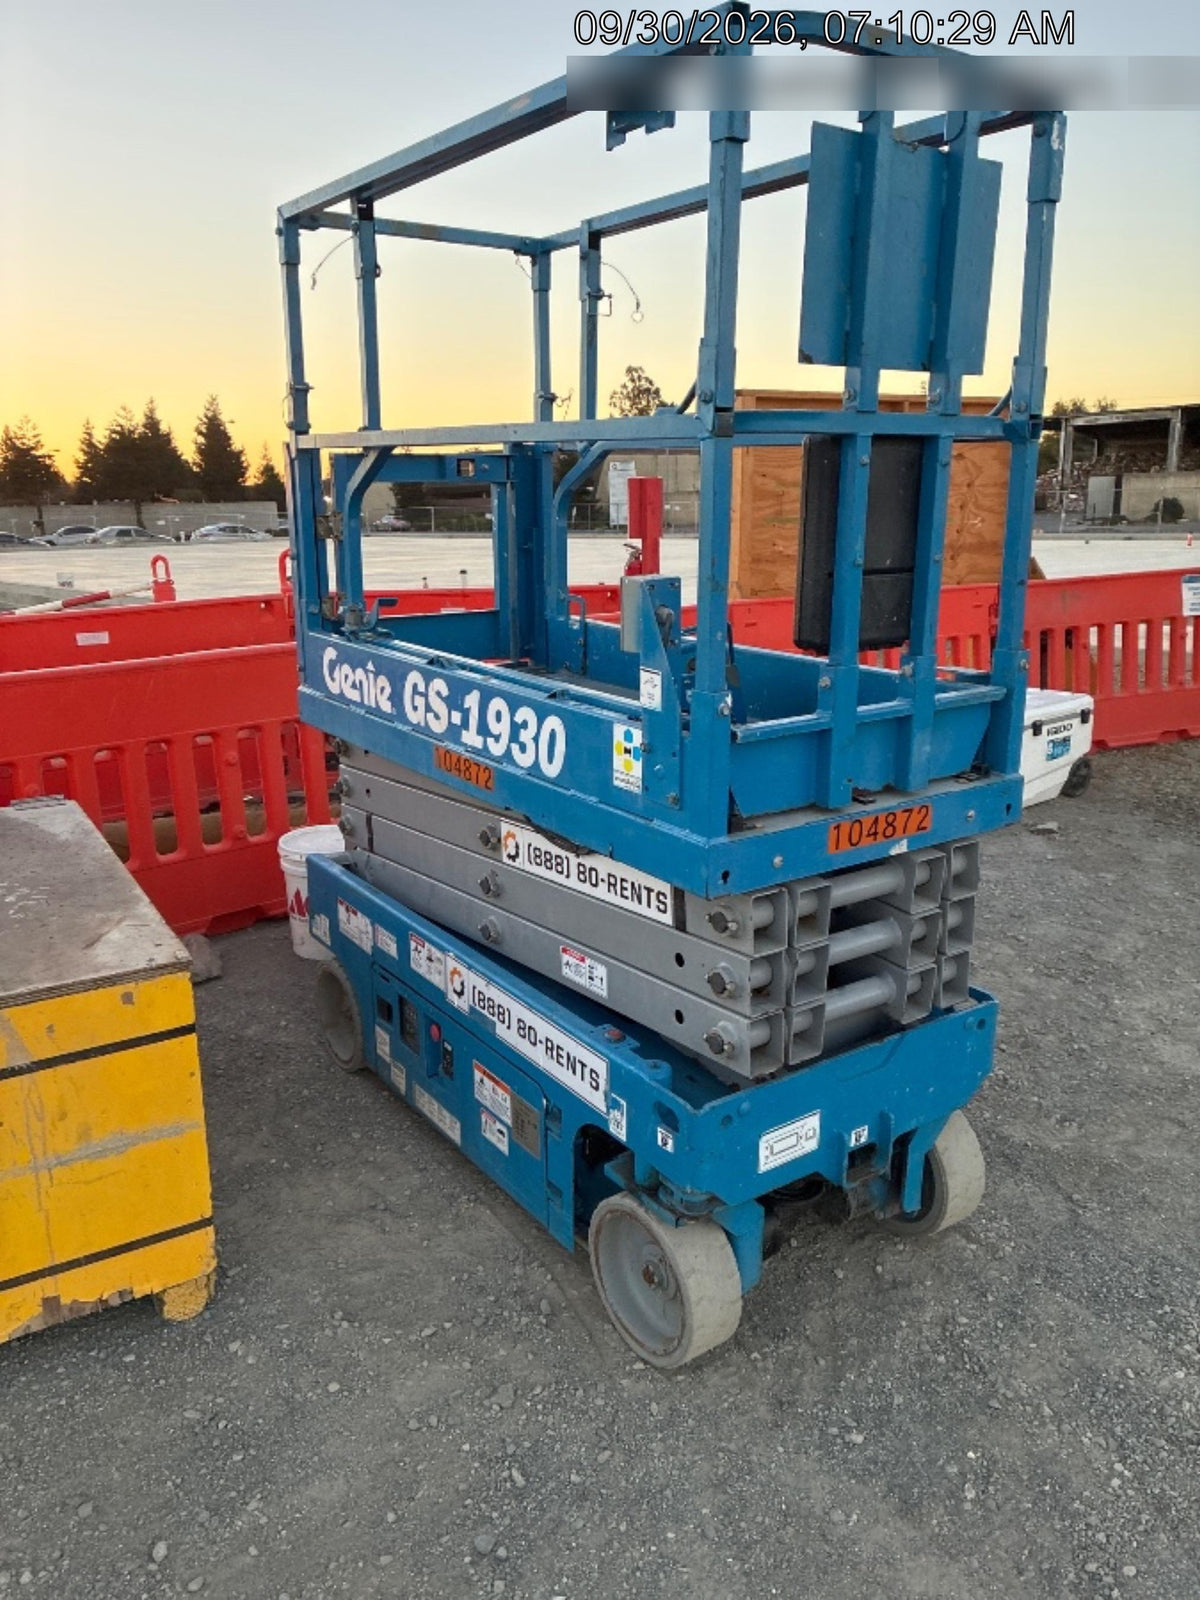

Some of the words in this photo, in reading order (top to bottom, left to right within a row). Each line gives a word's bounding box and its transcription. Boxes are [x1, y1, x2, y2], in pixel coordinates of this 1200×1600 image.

[323, 646, 392, 714] Genie
[403, 670, 566, 778] GS-1930
[434, 745, 493, 791] 104872
[833, 804, 929, 851] 104872
[527, 843, 570, 879] (888)
[577, 862, 668, 914] 80-RENTS
[472, 985, 511, 1030] (888)
[516, 1018, 600, 1092] 80-RENTS
